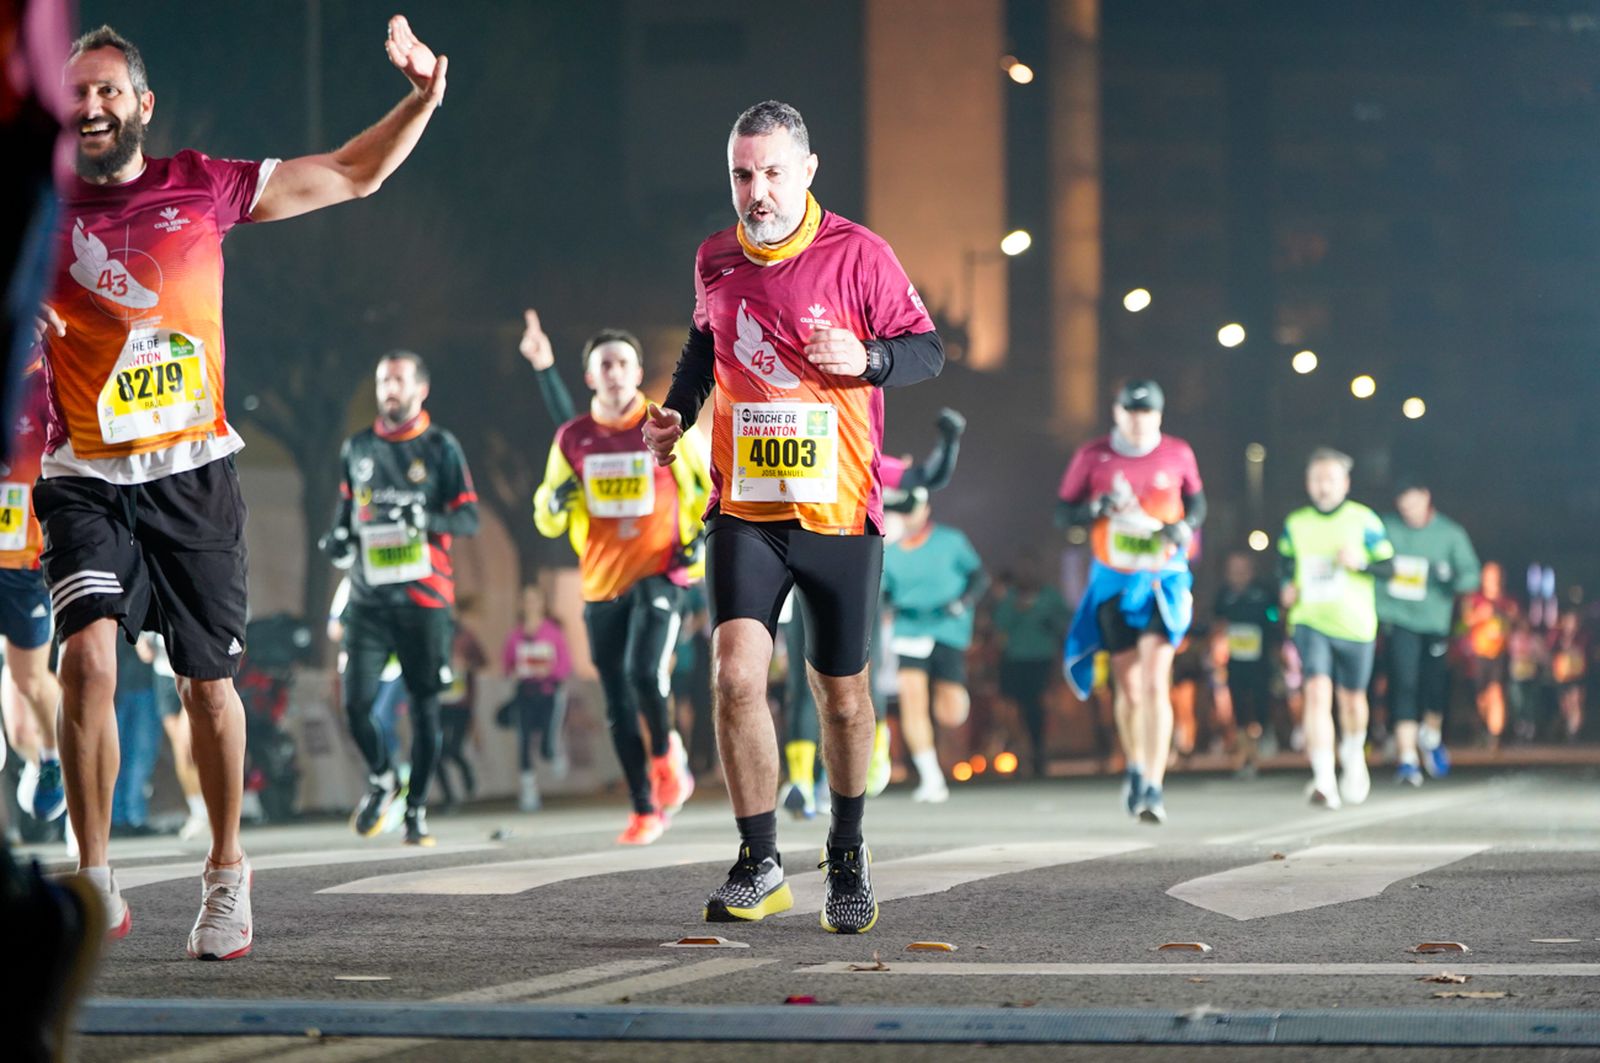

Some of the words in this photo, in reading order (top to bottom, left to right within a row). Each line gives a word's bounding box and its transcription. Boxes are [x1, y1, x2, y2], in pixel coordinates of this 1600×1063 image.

[96, 268, 128, 297] 43
[147, 338, 160, 350] DE
[750, 349, 776, 375] 43
[116, 361, 183, 402] 8279
[753, 414, 782, 424] NOCHE
[785, 414, 797, 424] DE
[742, 425, 761, 437] SAN
[763, 424, 797, 437] ANTÓN
[750, 438, 817, 468] 4003
[761, 469, 777, 477] JOSE
